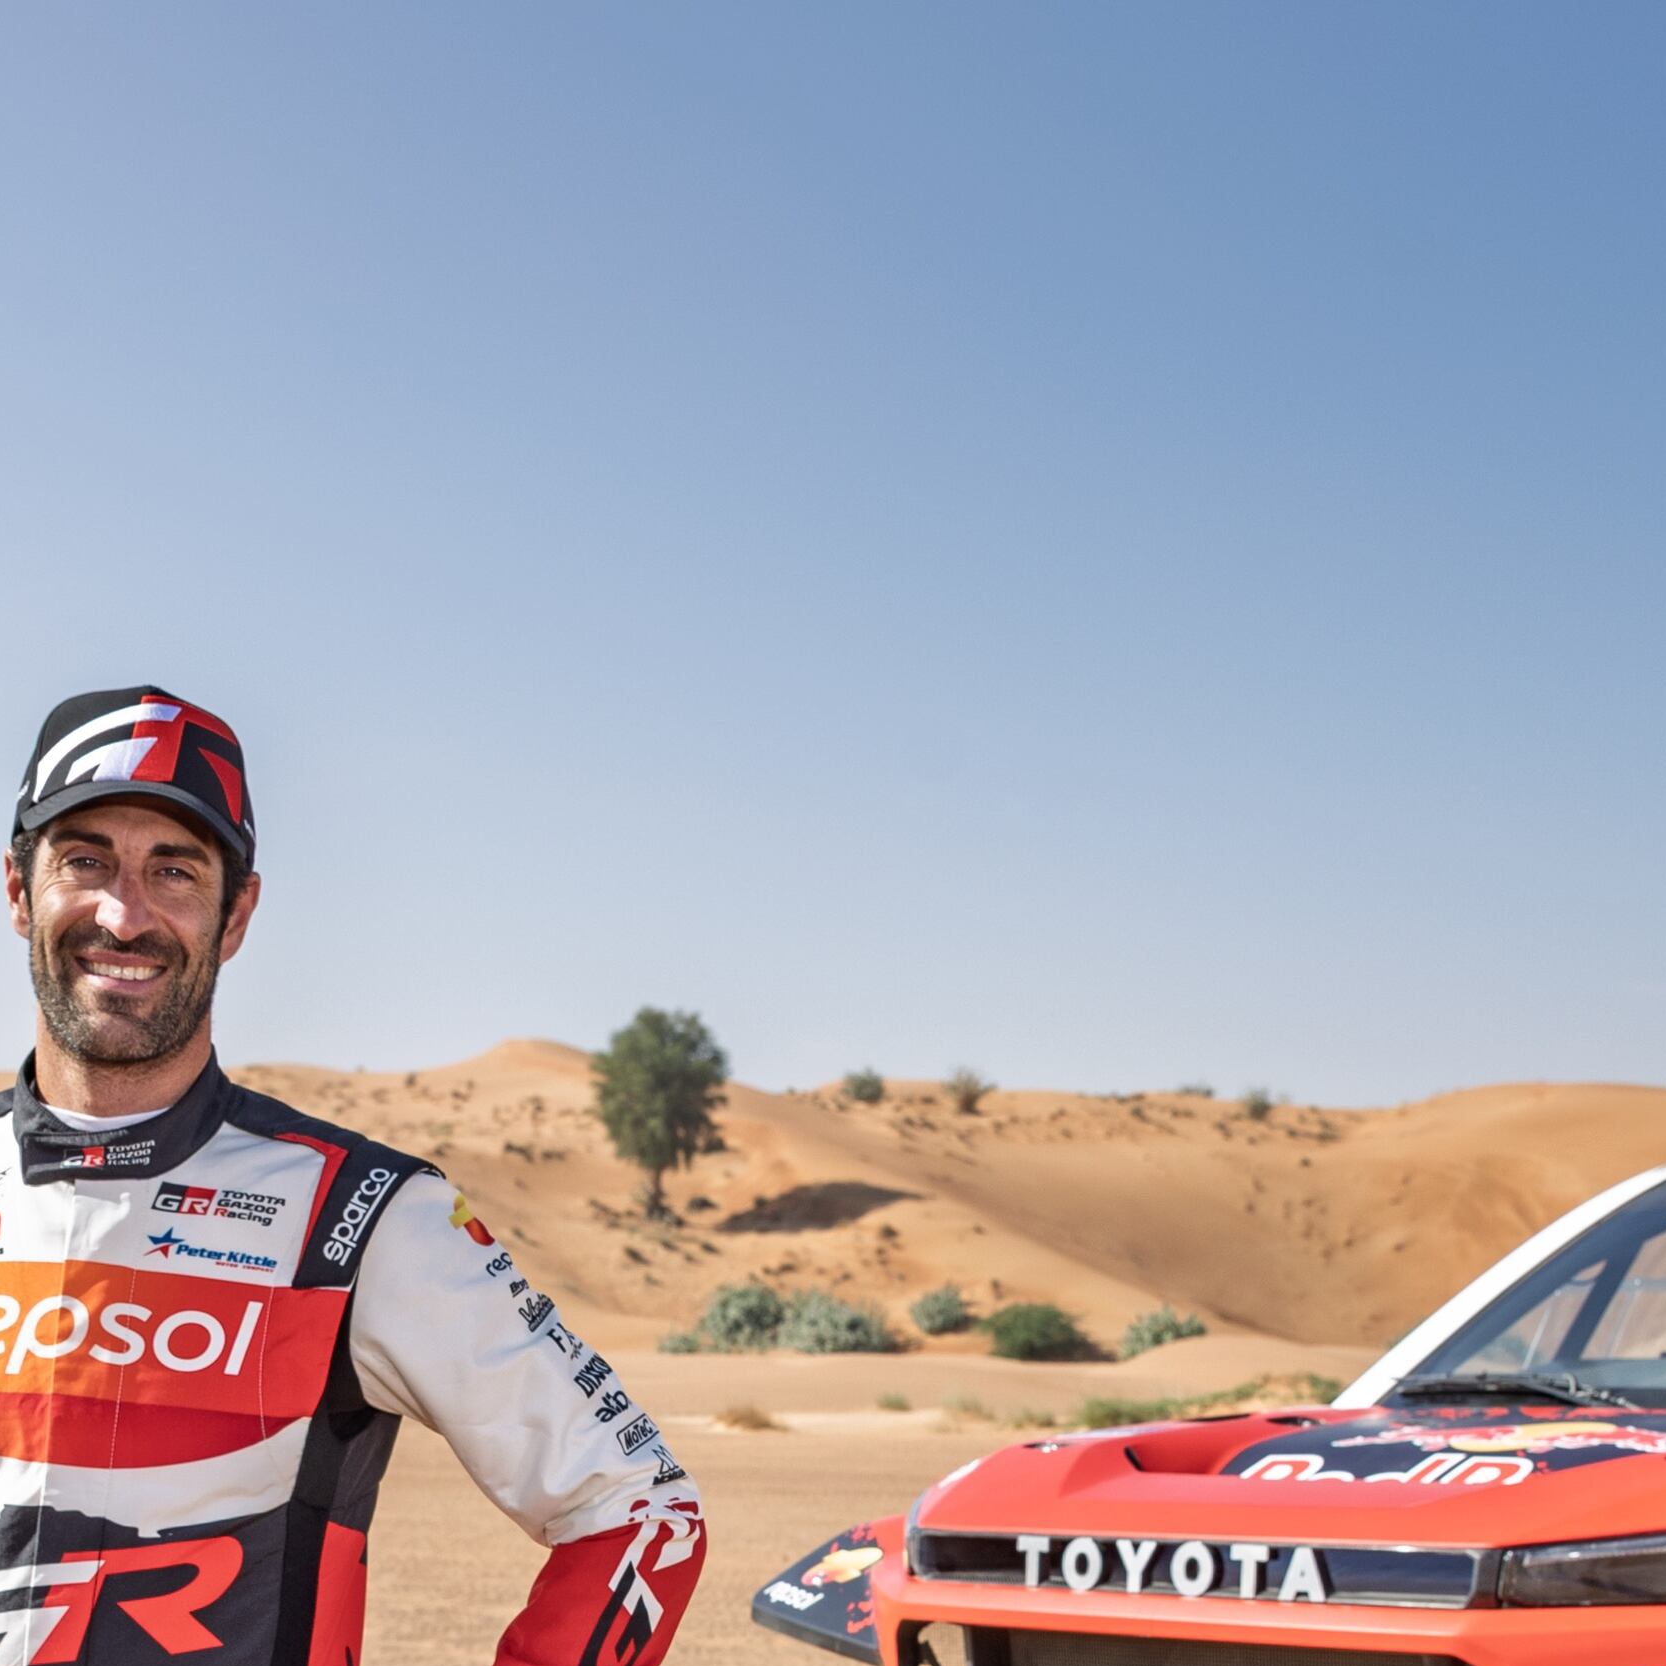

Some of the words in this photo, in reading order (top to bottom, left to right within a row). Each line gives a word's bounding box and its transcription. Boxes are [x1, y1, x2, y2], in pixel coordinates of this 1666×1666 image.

[106, 1148, 151, 1160] GAZOO
[107, 1140, 156, 1154] TOYOTA
[107, 1156, 150, 1166] Racing
[154, 1193, 210, 1214] GR
[217, 1199, 278, 1216] GAZOO
[222, 1190, 286, 1207] TOYOTA
[213, 1207, 273, 1227] Racing
[323, 1167, 399, 1267] sparco
[176, 1244, 226, 1261] Peter
[227, 1252, 278, 1269] Kittle
[485, 1252, 514, 1278] rep
[594, 1390, 633, 1423] alb
[1016, 1534, 1327, 1602] TOYOTA
